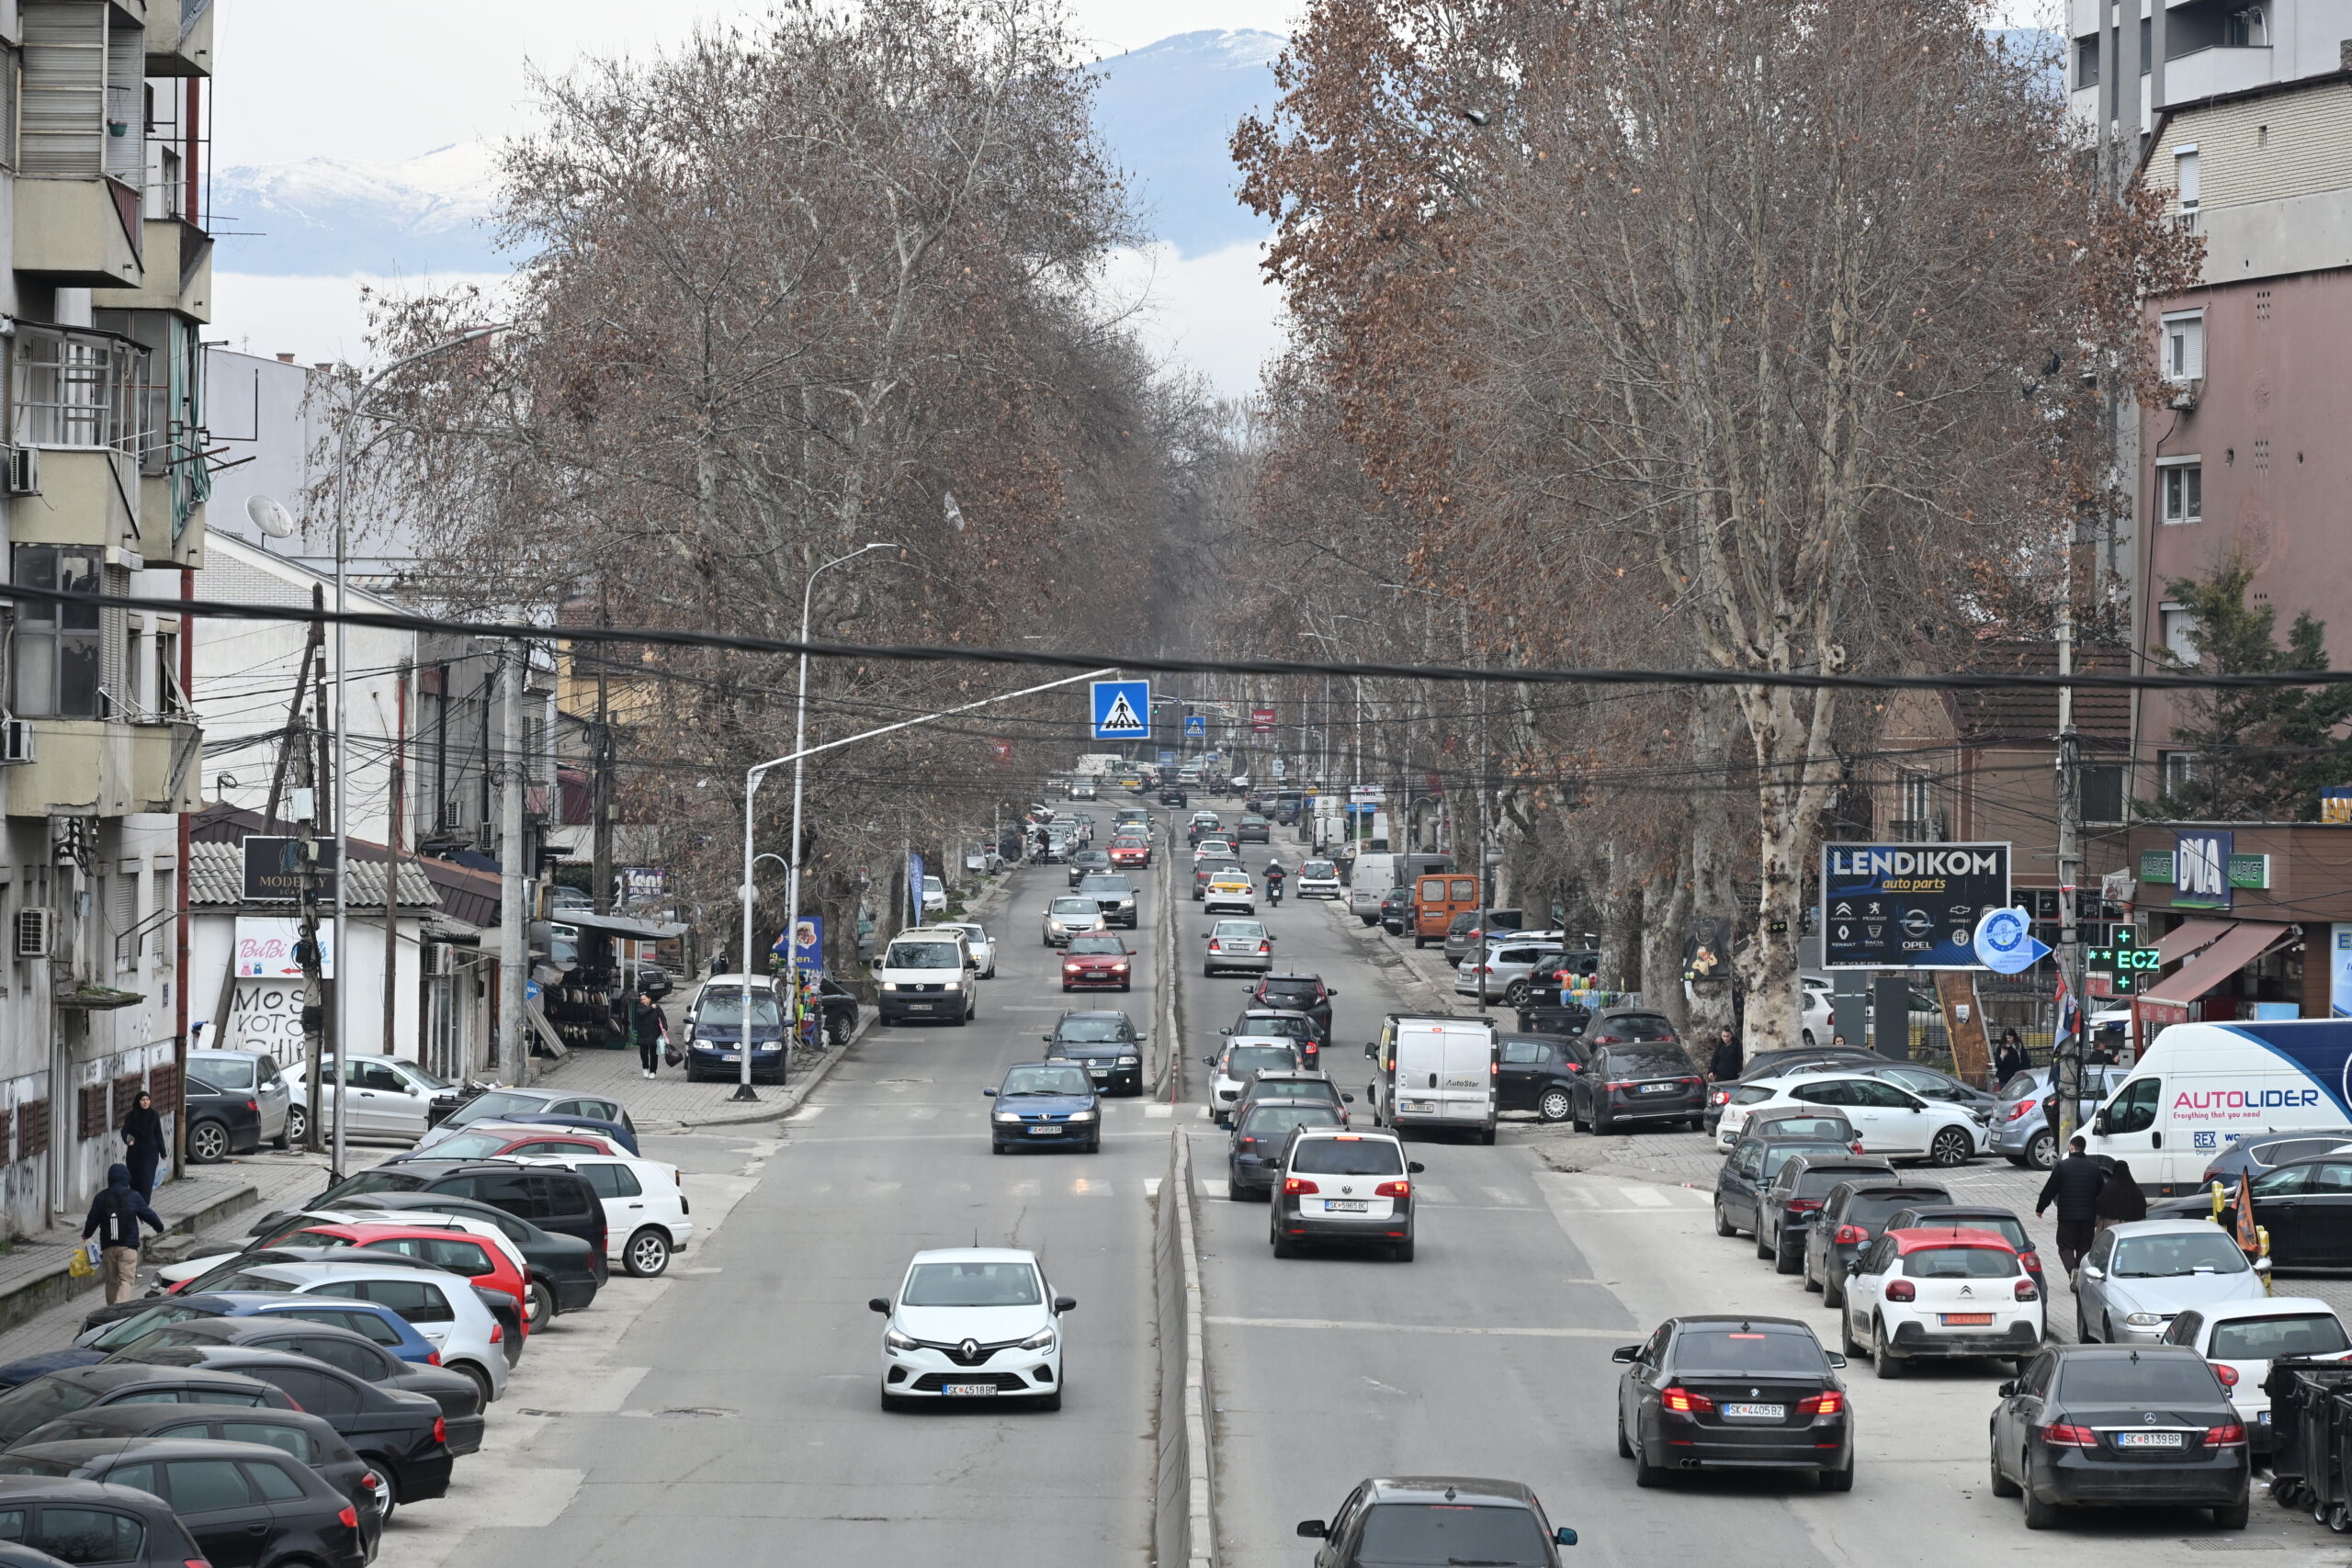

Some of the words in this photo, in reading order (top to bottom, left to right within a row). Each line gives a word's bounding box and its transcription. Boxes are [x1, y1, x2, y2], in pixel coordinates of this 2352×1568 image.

[1834, 852, 1996, 875] LENDIKOM
[259, 875, 327, 888] MODEY
[1882, 879, 1911, 889] auto
[1912, 877, 1947, 892] parts
[240, 938, 287, 959] BuBi
[1902, 941, 1933, 950] OPEL
[2118, 951, 2160, 969] ECZ
[1446, 1079, 1479, 1088] AutoStar
[2174, 1089, 2319, 1110] AUTOLIDER
[2173, 1111, 2210, 1121] Everything
[2227, 1111, 2241, 1120] you
[2243, 1110, 2261, 1118] need
[2194, 1134, 2217, 1146] REX
